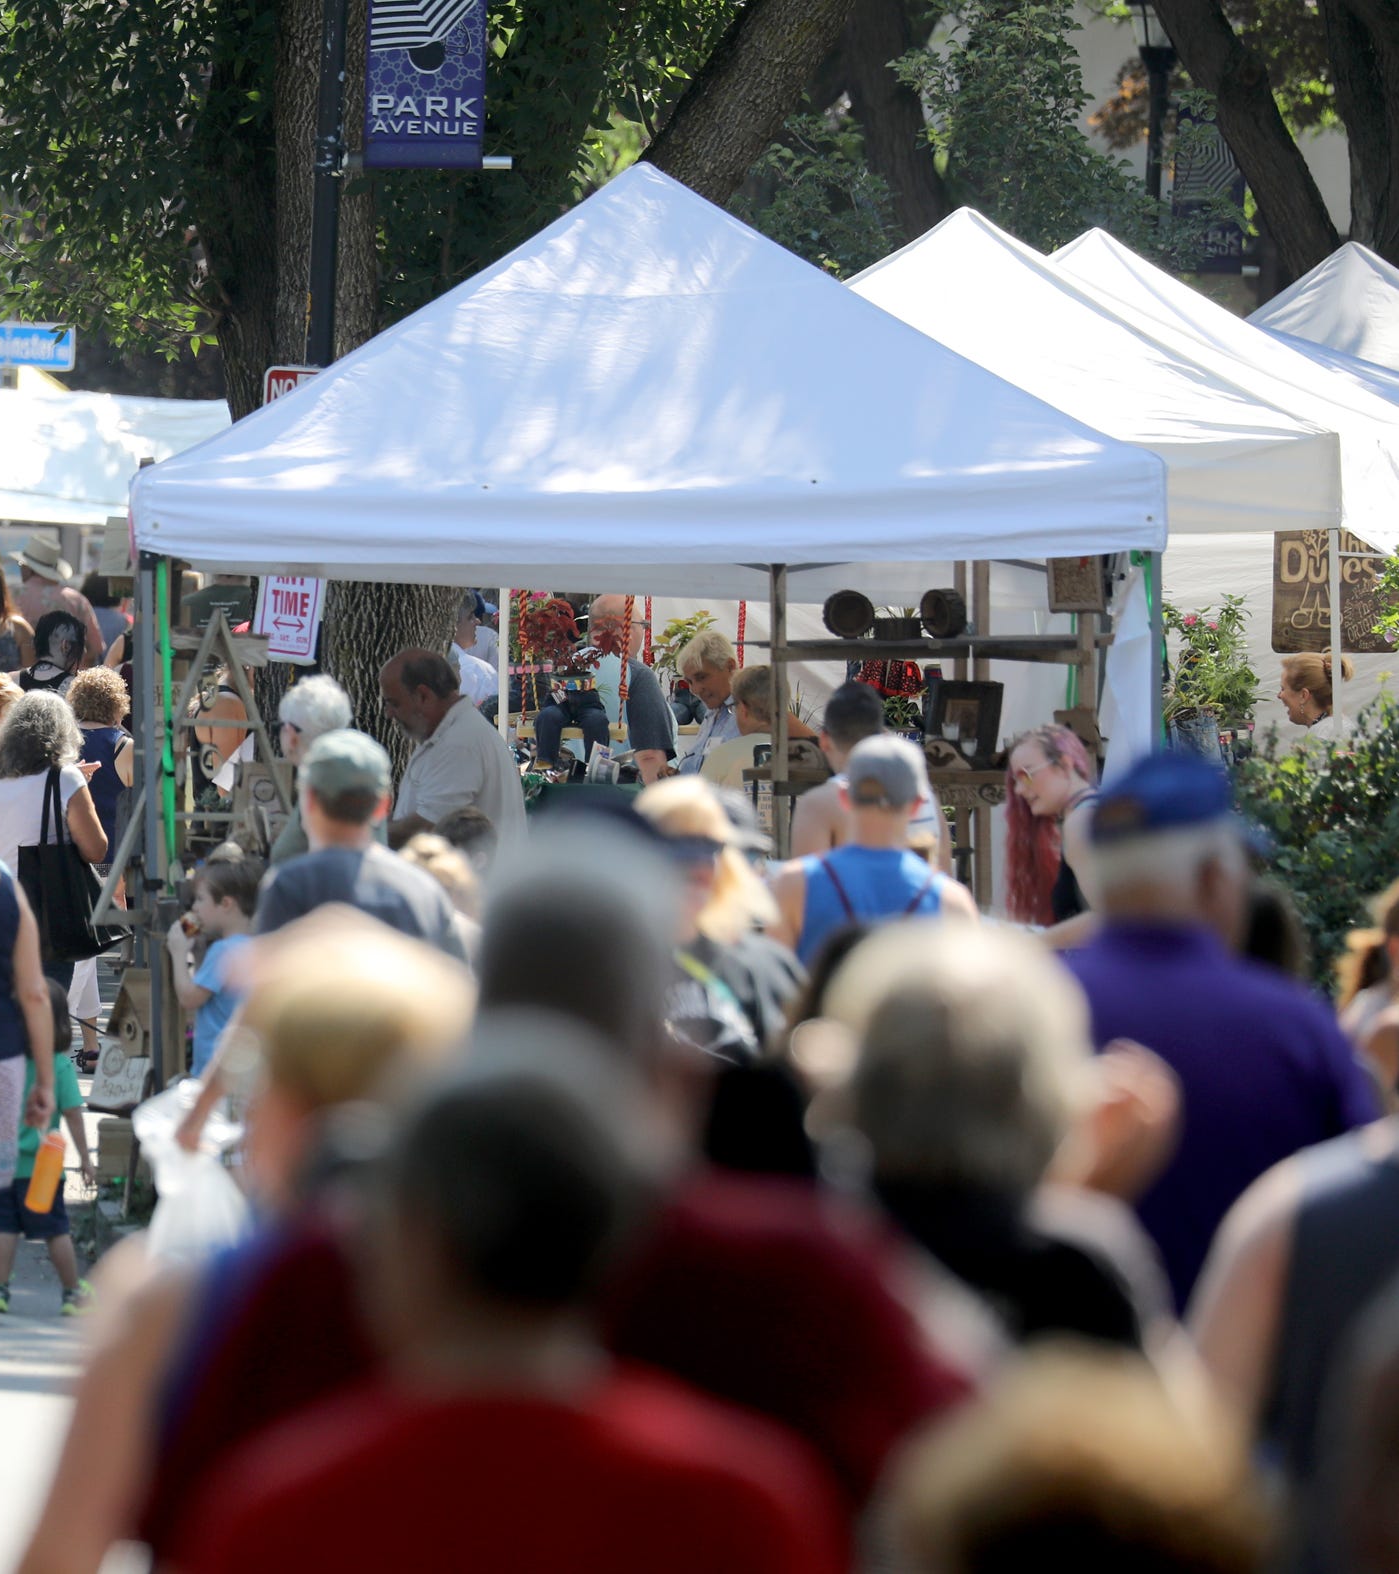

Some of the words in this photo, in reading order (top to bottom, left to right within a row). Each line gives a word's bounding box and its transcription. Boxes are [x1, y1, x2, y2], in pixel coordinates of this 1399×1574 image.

[371, 94, 479, 119] PARK
[371, 120, 478, 135] AVENUE
[271, 378, 296, 400] NO
[1281, 540, 1381, 584] Dues
[272, 589, 310, 617] TIME
